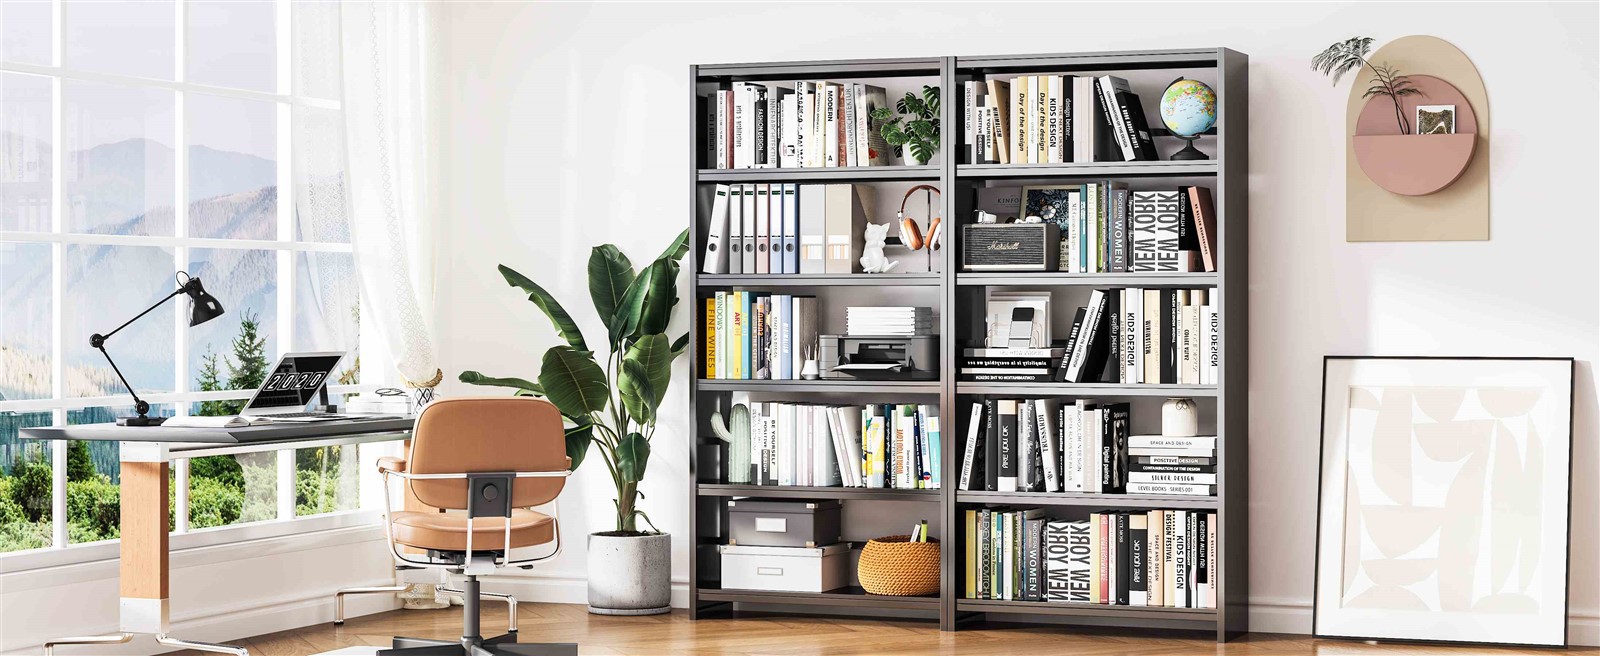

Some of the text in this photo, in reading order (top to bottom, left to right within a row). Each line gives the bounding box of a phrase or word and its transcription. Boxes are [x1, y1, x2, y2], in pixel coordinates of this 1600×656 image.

[992, 107, 1002, 137] MINIMALISM
[1131, 134, 1139, 148] POINTS
[987, 241, 1020, 250] Marshall
[267, 374, 322, 389] 2020
[771, 420, 775, 429] BE
[1038, 414, 1048, 452] TRUSSARDI
